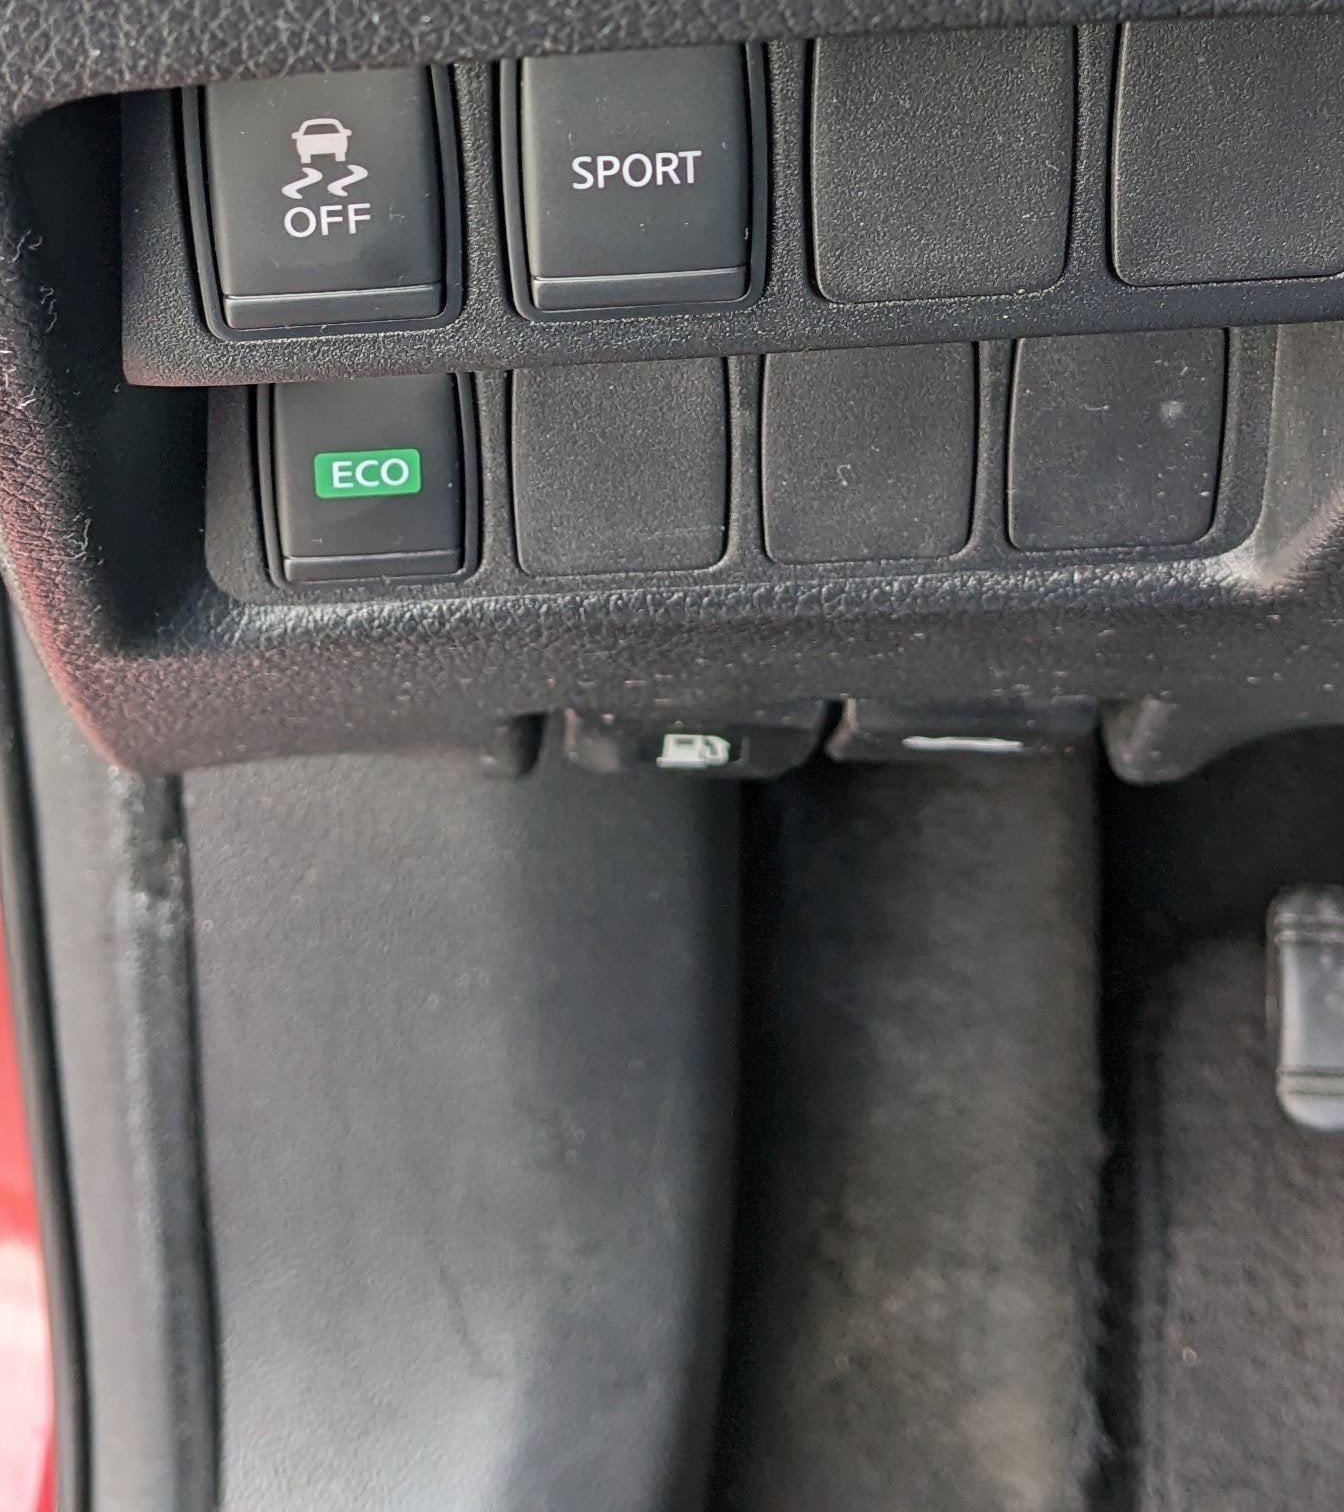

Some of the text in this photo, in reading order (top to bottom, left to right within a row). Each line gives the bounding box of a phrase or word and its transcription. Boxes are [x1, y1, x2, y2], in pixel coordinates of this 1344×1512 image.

[570, 150, 703, 190] SPORT
[282, 202, 372, 239] OFF
[330, 457, 411, 489] ECO
